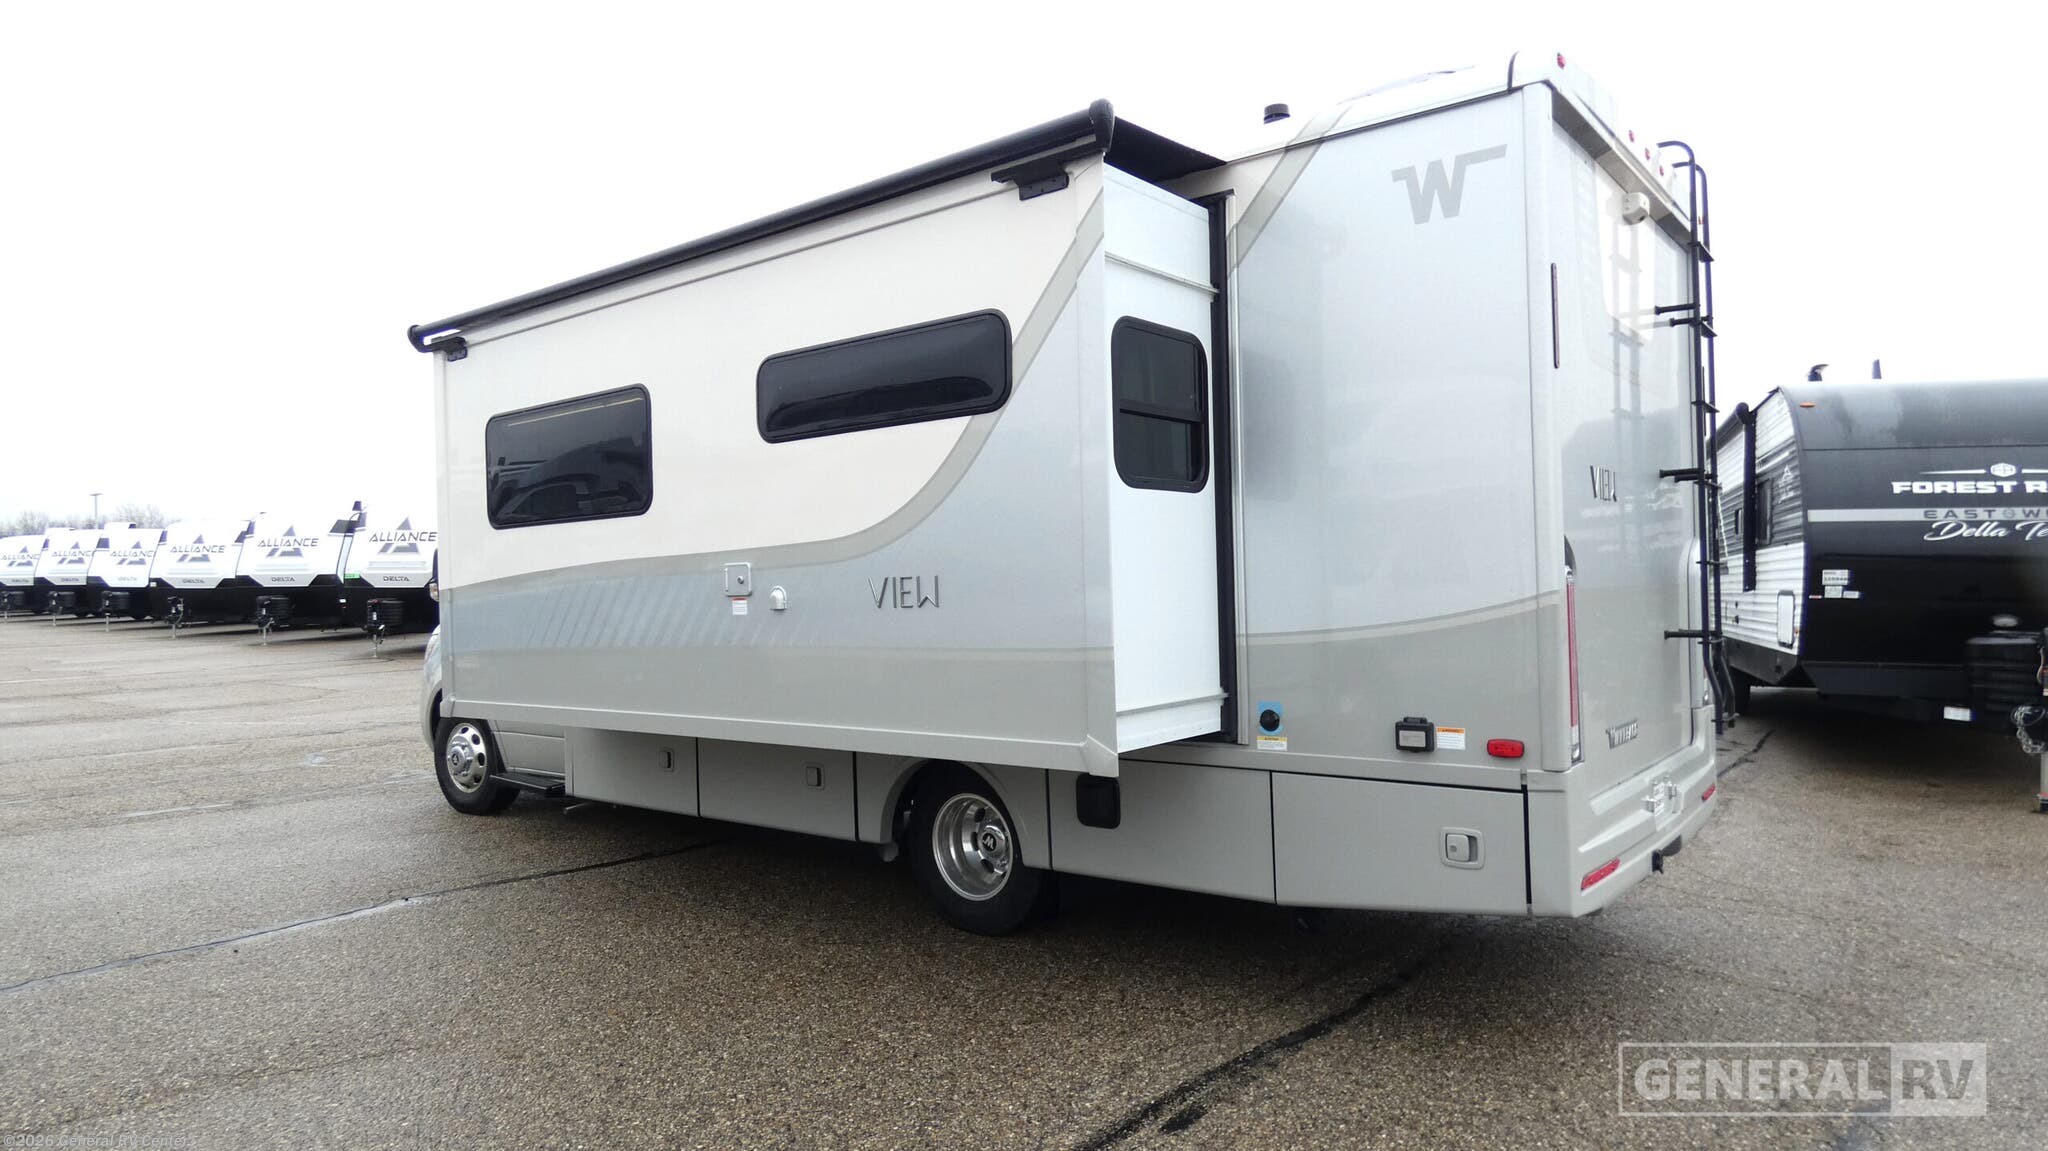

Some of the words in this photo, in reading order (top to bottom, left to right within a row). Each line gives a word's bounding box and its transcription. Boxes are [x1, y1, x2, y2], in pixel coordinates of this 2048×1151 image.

[1891, 480, 2018, 494] FOREST
[1923, 508, 1997, 519] EAST
[2022, 508, 2048, 519] W
[1923, 520, 2011, 541] Della
[368, 531, 437, 542] ALLIANCE
[257, 538, 319, 548] ALLIANCE
[169, 544, 226, 554] ALLIANCE
[867, 575, 940, 609] VIEW
